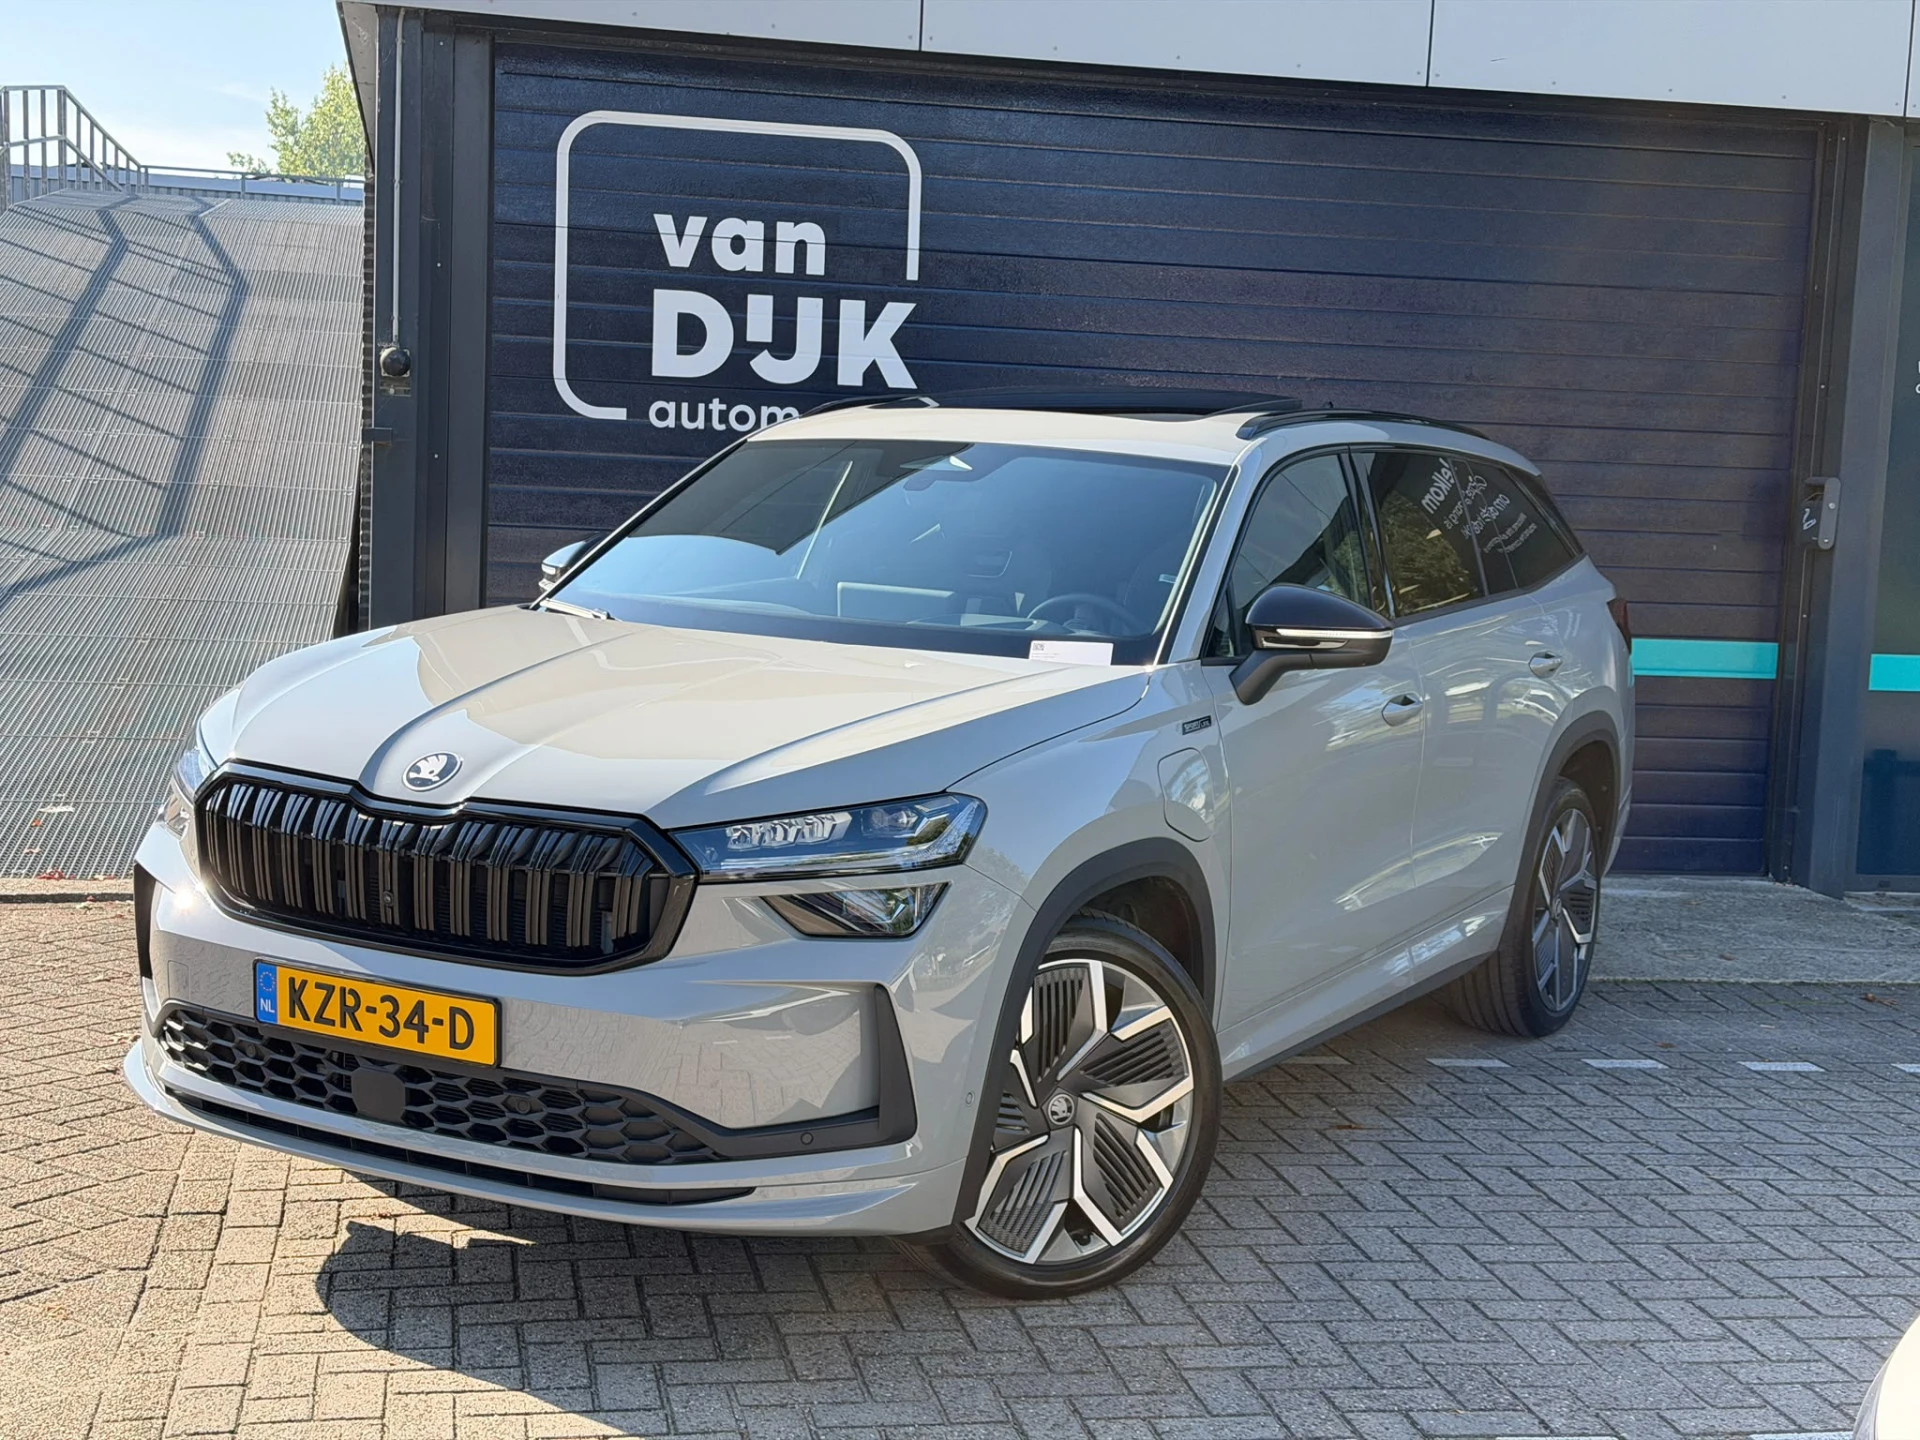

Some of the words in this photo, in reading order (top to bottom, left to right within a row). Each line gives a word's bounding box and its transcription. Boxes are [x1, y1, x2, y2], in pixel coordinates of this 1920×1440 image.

[653, 213, 826, 276] van
[651, 288, 918, 390] DIJK
[260, 998, 275, 1014] NL
[288, 976, 475, 1050] KZR-34-D
